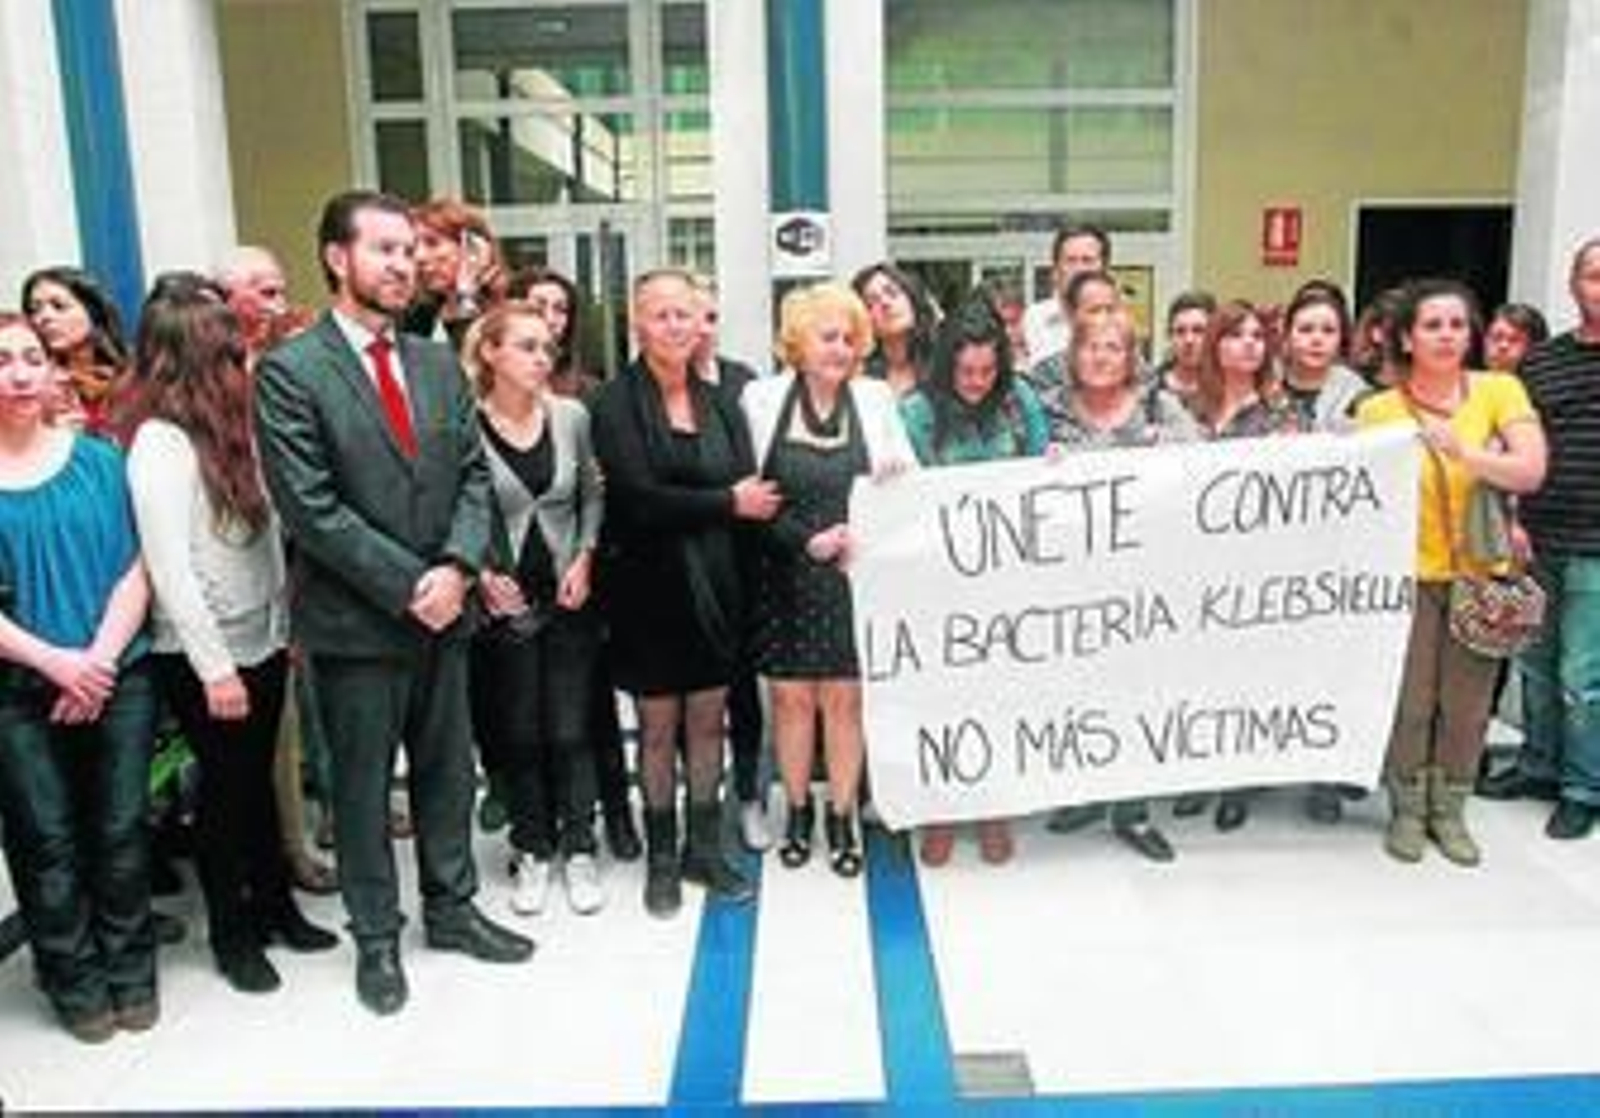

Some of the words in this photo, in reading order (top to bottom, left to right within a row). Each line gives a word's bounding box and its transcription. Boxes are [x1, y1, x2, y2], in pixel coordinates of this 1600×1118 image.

[940, 476, 1142, 577] ÚNETE
[1196, 465, 1381, 534] CONTRA
[866, 617, 922, 681] LA
[917, 717, 992, 786] NO
[1016, 708, 1120, 774] MÁS
[1136, 702, 1341, 765] VÍCTIMAS
